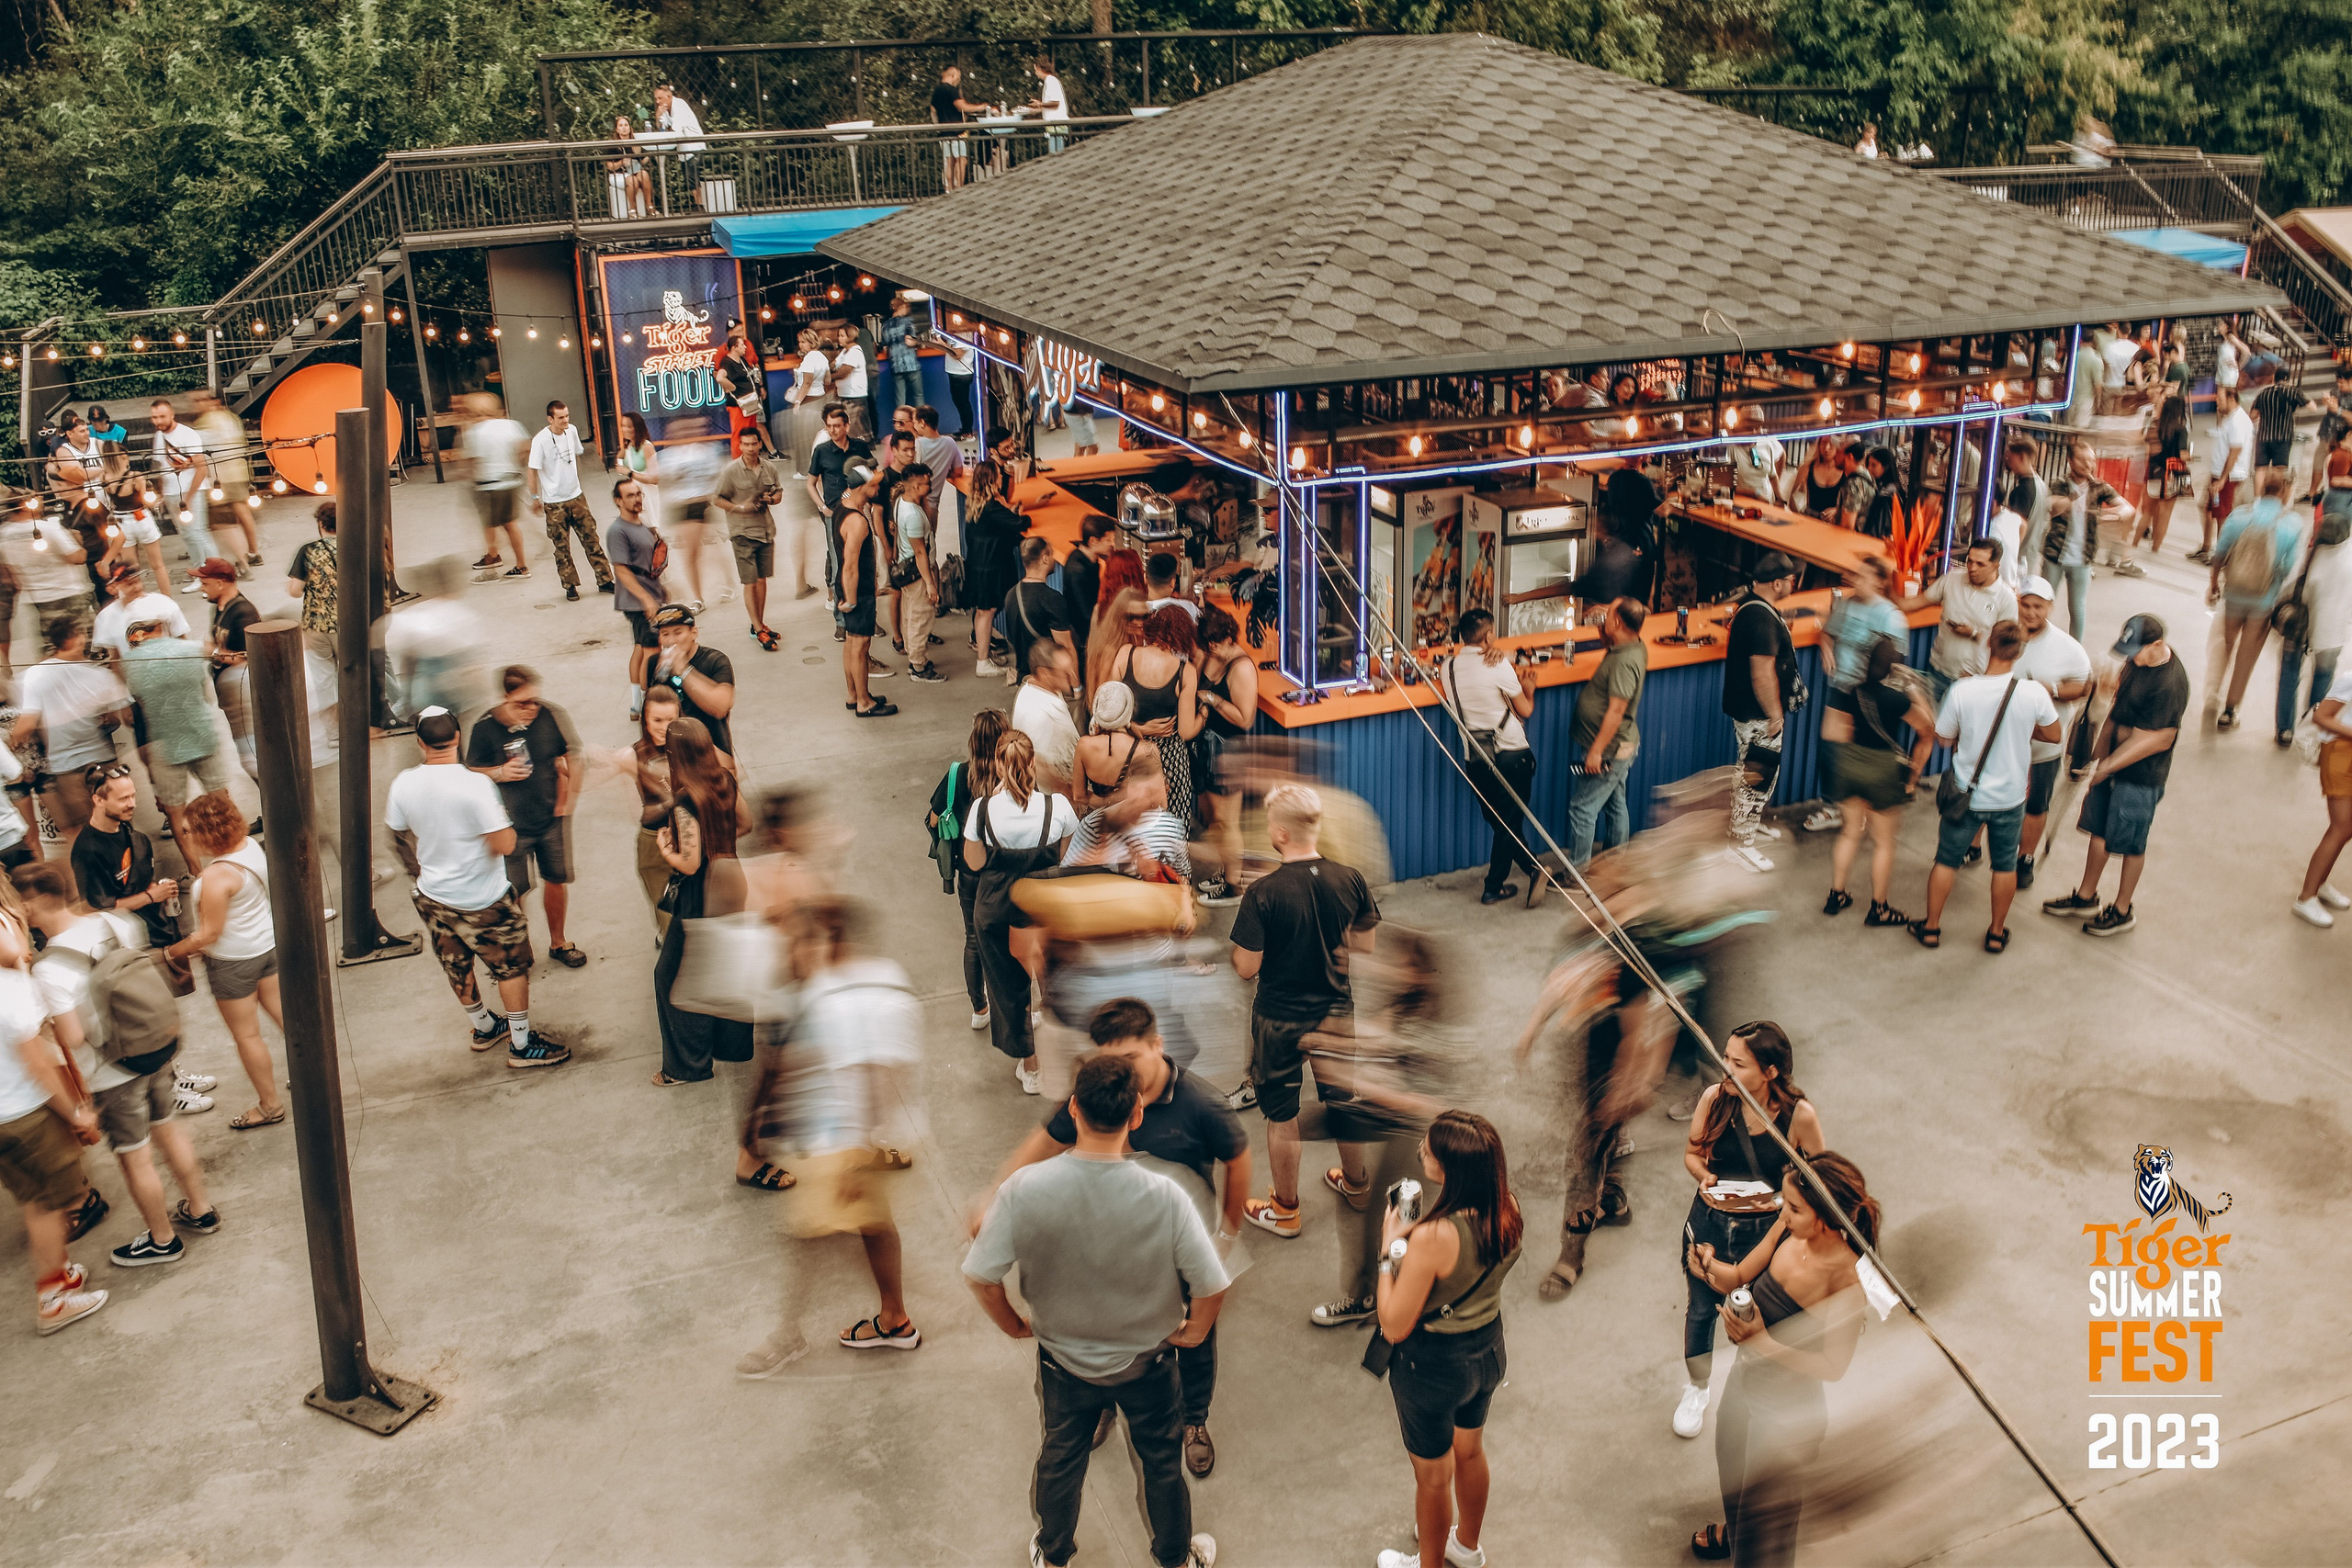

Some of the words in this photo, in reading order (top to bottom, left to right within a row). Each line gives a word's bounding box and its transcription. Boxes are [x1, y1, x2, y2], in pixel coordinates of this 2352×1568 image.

[641, 321, 712, 356] Tiger
[642, 349, 718, 375] STREET
[637, 364, 727, 412] FOOD
[37, 818, 62, 839] ige
